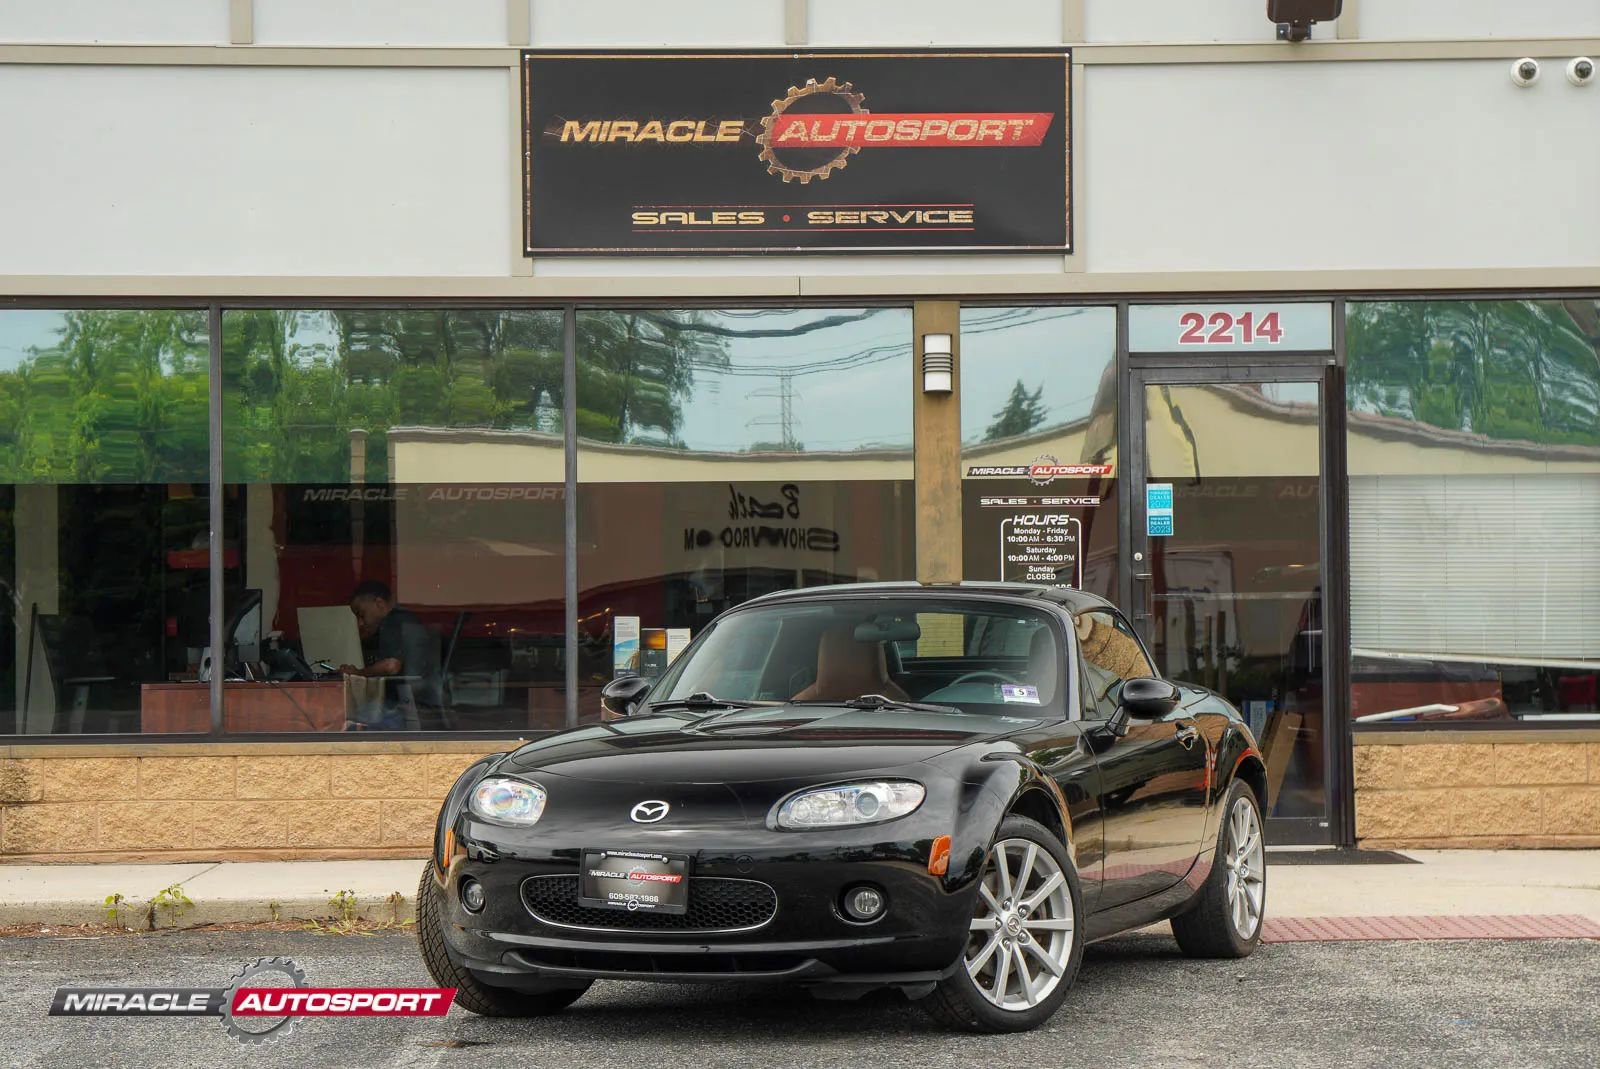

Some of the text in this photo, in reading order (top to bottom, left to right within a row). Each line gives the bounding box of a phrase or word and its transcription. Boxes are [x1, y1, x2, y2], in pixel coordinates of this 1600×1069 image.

[560, 119, 1024, 142] MIRACLE AUTOSPORT
[632, 209, 974, 225] SALES SERVICE
[1178, 311, 1284, 345] 2214
[972, 466, 1108, 475] MIRACLE AUTOSPORT
[303, 488, 409, 501] MIRACLE
[1041, 497, 1100, 505] SERVICE
[1013, 514, 1071, 526] HOURS
[1013, 527, 1069, 535] Monday Friday
[1026, 546, 1057, 554] Saturday
[1028, 565, 1055, 573] Sunday
[591, 869, 678, 882] MIRACLE AUTOSPORT
